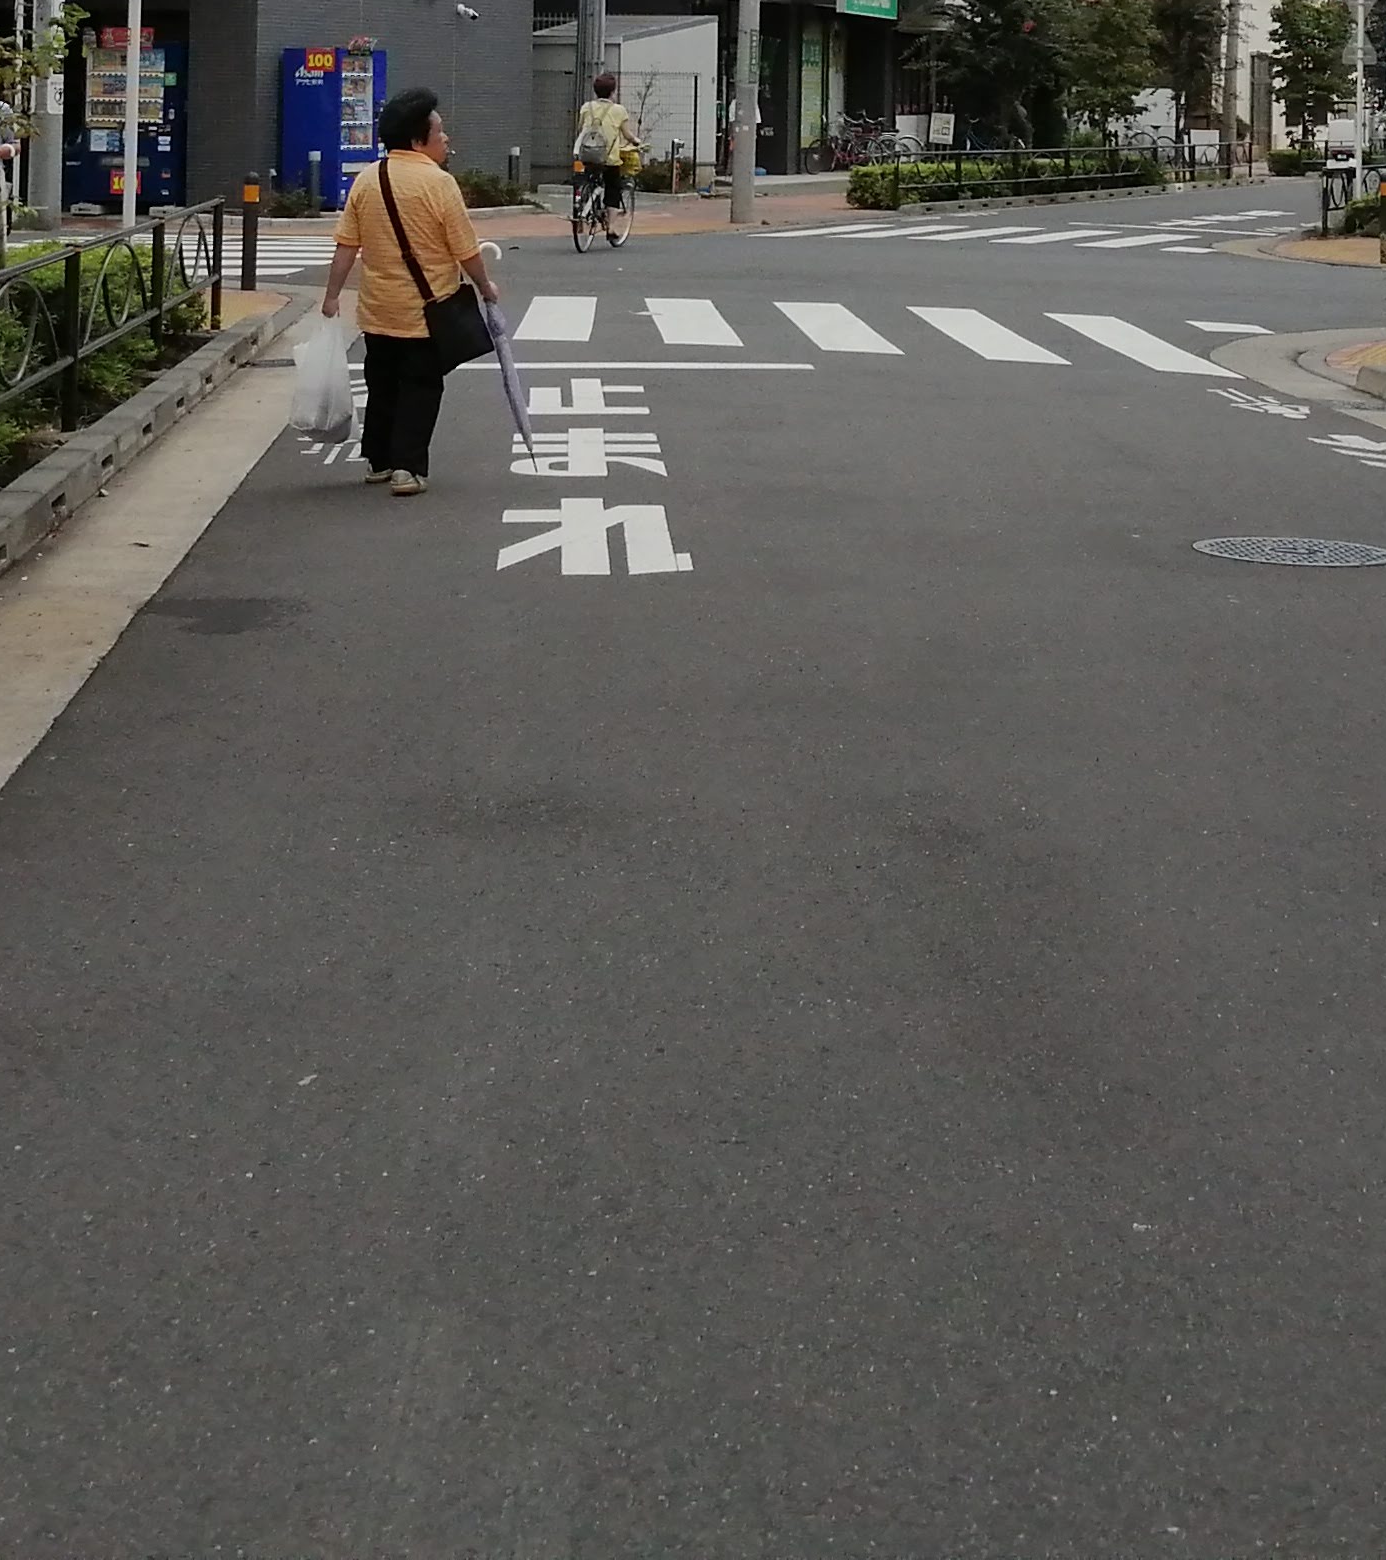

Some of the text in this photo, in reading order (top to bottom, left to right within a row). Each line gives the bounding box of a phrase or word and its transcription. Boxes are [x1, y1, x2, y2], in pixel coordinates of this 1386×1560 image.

[308, 53, 333, 67] 100
[496, 378, 694, 576] 止まれ
